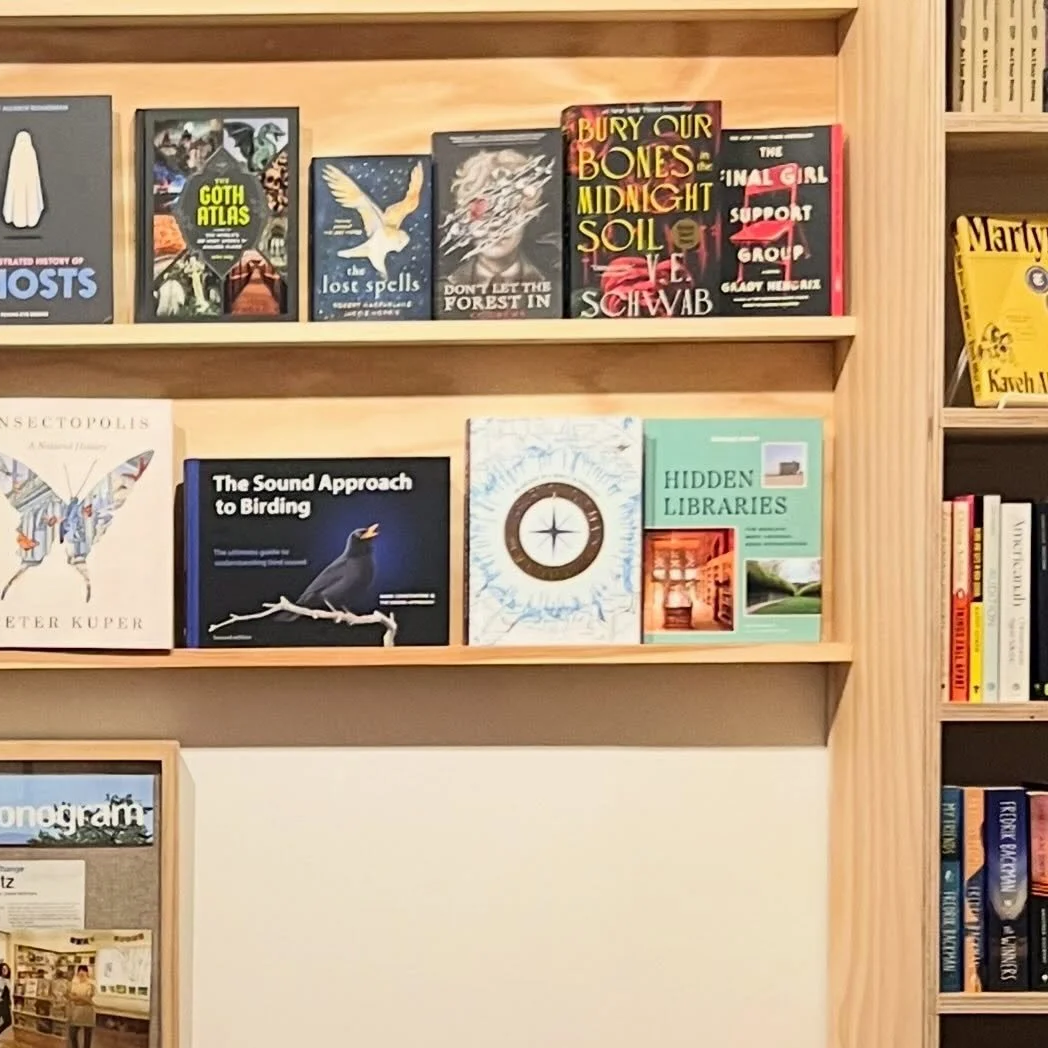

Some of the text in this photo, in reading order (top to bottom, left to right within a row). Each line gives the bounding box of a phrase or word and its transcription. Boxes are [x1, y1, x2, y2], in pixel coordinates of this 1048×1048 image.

[578, 113, 712, 142] BURY OUR
[759, 146, 783, 158] THE
[578, 145, 694, 180] BONES
[779, 168, 829, 185] GIRL
[199, 185, 245, 205] GOTH
[577, 182, 713, 214] MIDNIGHT
[197, 206, 250, 226] ATLAS
[730, 205, 813, 223] SUPPORT
[577, 218, 664, 252] SOIL
[35, 257, 70, 266] HISTORY
[737, 246, 805, 264] GROUP
[347, 266, 366, 276] the
[322, 272, 420, 298] lost spells
[444, 281, 552, 296] DON'T LET THE
[444, 294, 551, 311] FOREST IN
[580, 288, 713, 318] SCHWAB
[212, 472, 413, 494] The Sound Approach
[665, 470, 754, 489] HIDDEN
[216, 497, 311, 518] to Birding
[664, 497, 787, 515] LIBRARIES
[1012, 520, 1026, 607] Americanah
[72, 616, 143, 629] KUPER
[943, 820, 956, 854] FRIENDS
[1000, 801, 1017, 980] FREDRIK BACKMAN WINNERS
[943, 892, 956, 926] FREDRIK
[943, 929, 956, 972] BACKMAN
